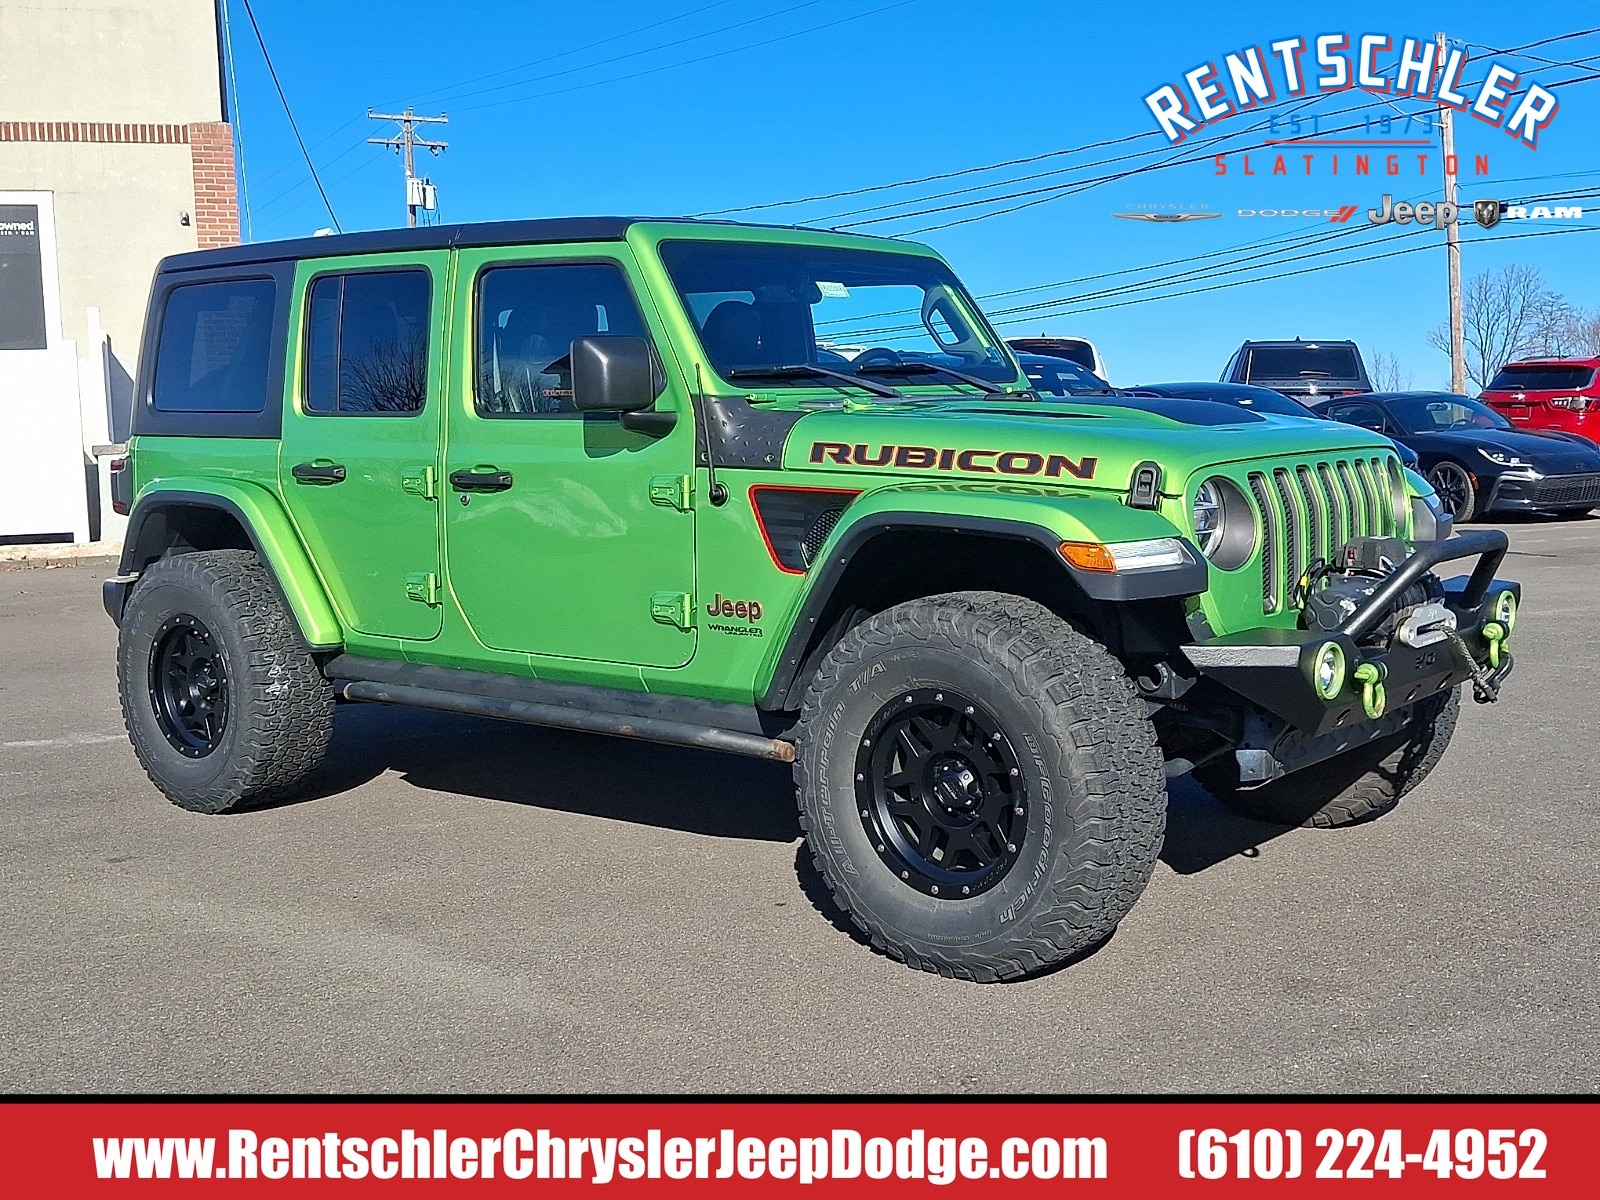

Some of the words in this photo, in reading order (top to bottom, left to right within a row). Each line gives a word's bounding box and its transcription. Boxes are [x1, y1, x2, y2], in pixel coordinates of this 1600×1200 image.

[808, 440, 1099, 480] RUBICON
[706, 592, 763, 624] Jeep
[707, 622, 763, 635] WRANGLER
[998, 732, 1054, 925] BFGoodrich
